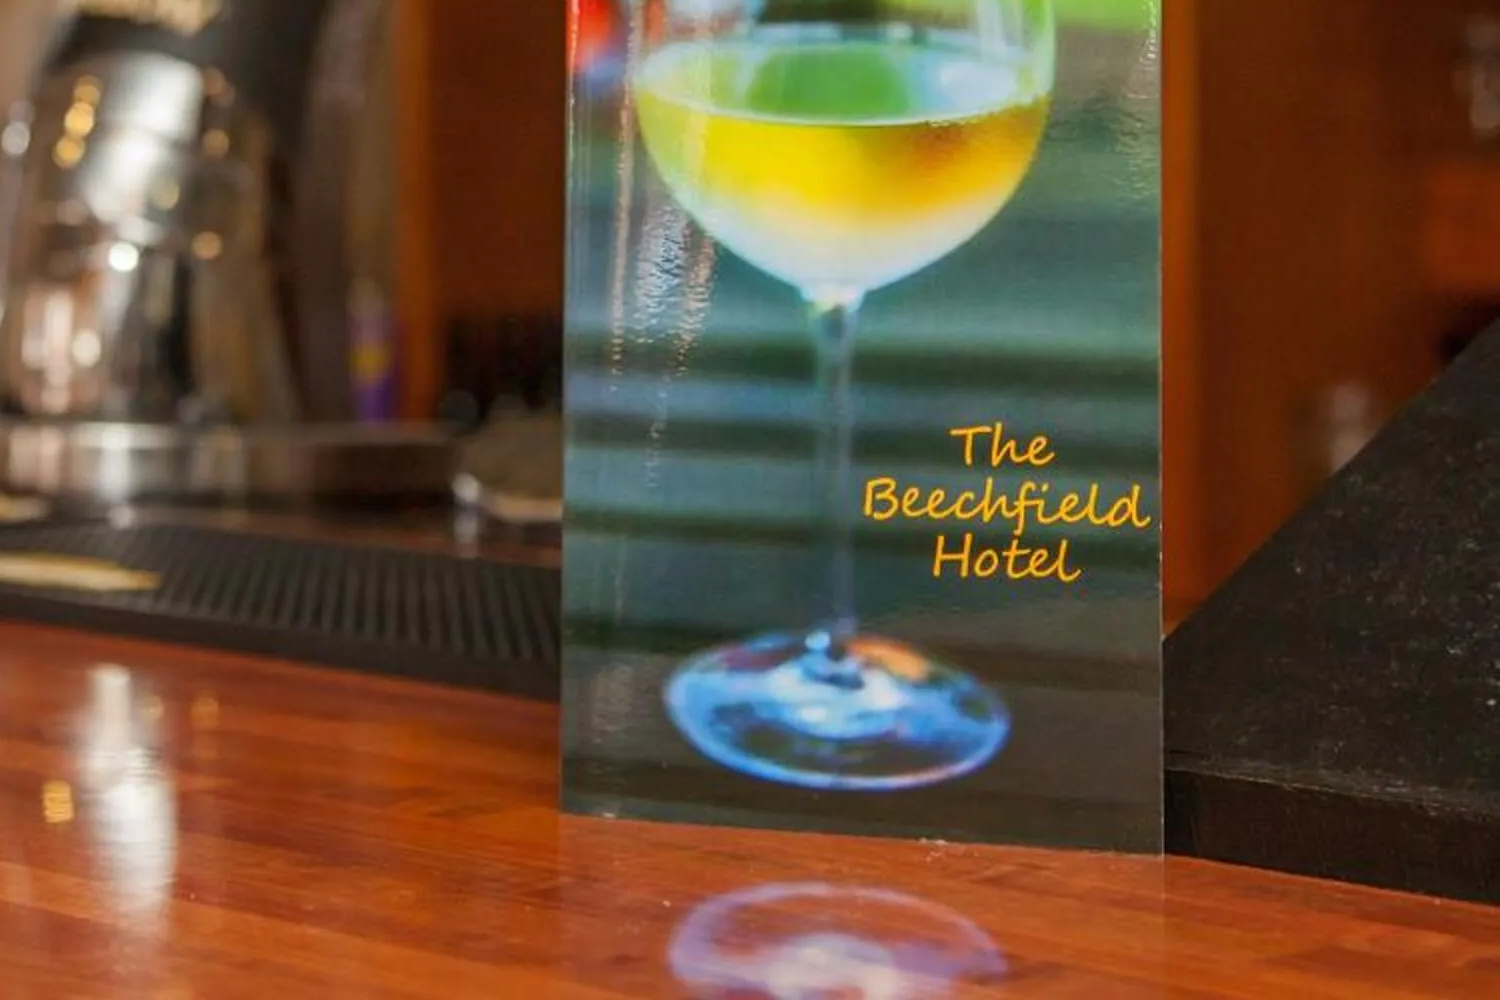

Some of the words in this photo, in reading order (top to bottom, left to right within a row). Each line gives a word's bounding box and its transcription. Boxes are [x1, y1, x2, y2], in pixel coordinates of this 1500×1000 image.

[949, 421, 1055, 466] The
[862, 476, 1152, 535] Beechfield
[932, 532, 1082, 583] Hotel
